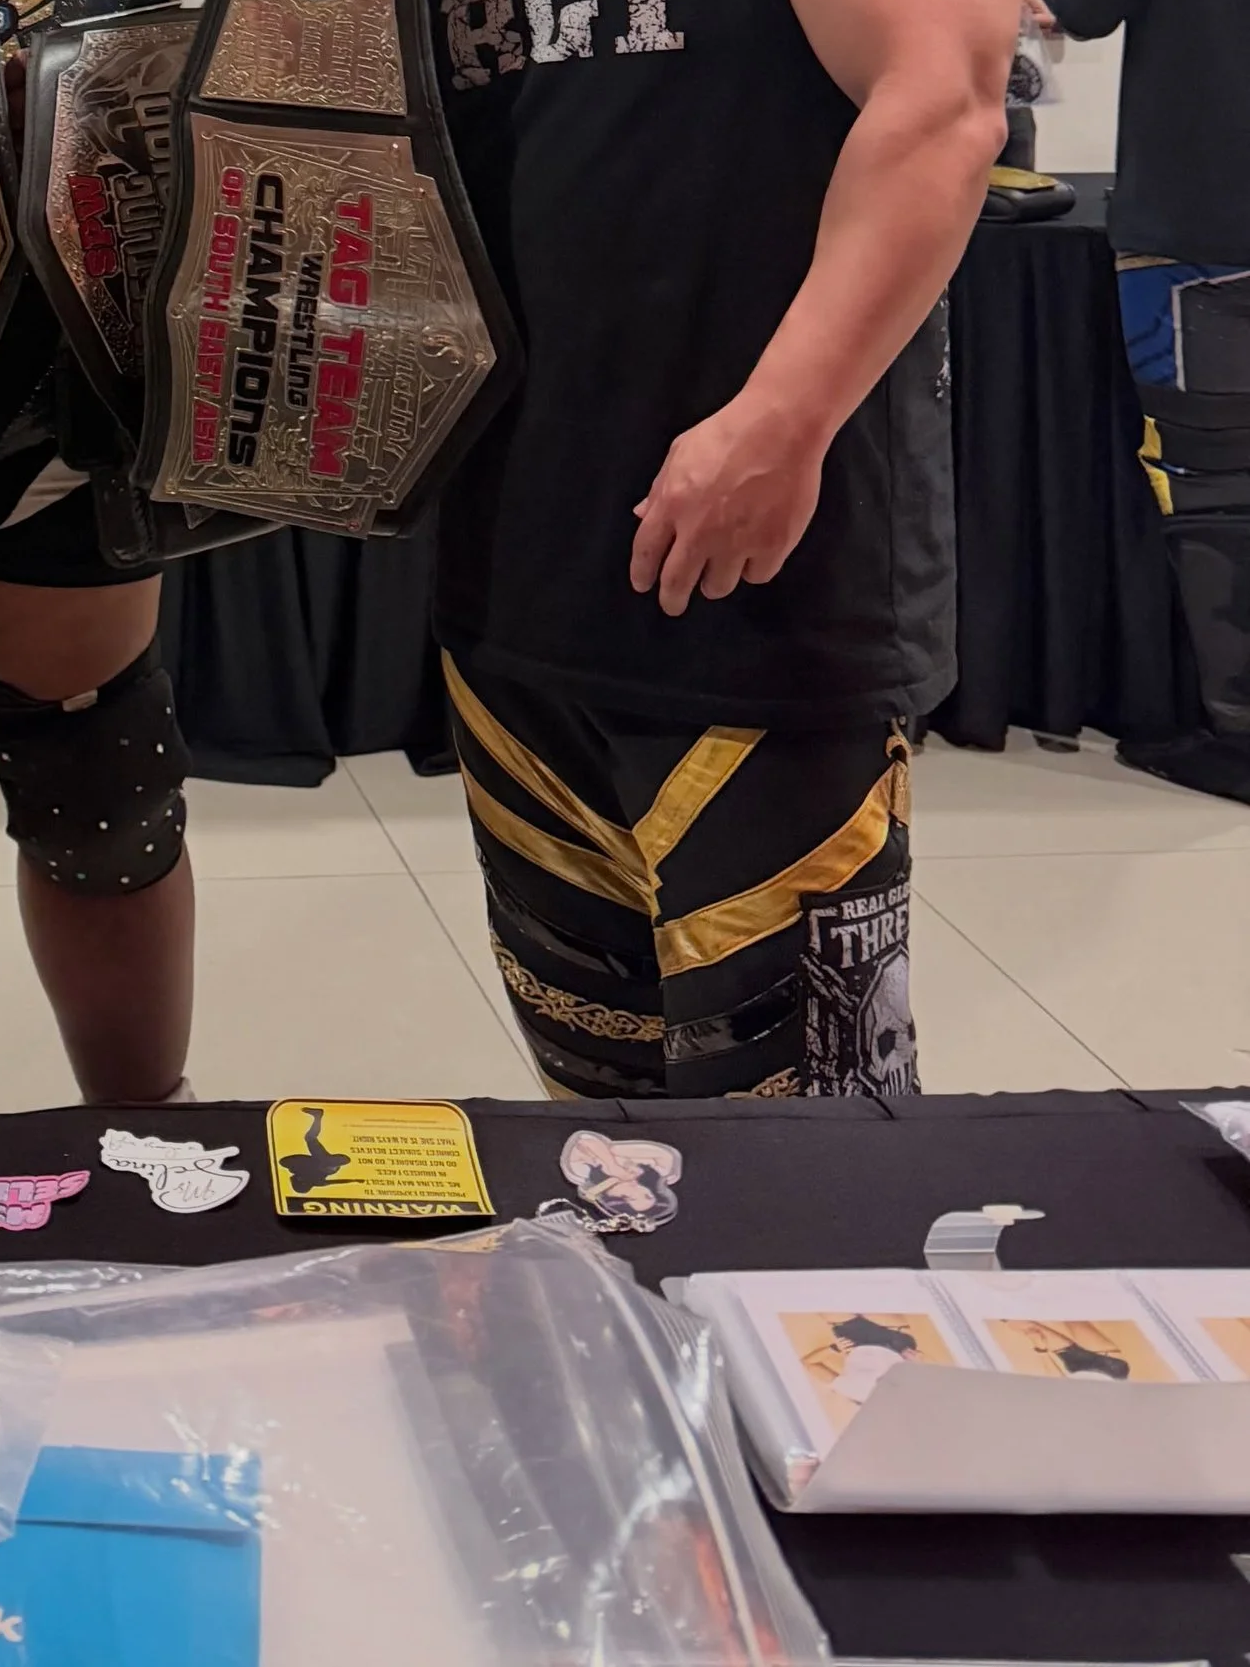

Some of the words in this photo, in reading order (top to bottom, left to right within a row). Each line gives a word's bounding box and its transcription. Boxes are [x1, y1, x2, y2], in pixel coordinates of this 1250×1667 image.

[67, 174, 117, 277] SPW
[219, 167, 247, 209] OF
[203, 212, 242, 315] SOUTH
[327, 192, 376, 309] TAG
[193, 316, 232, 397] EAST
[226, 173, 286, 473] CHAMPIONS
[285, 251, 327, 413] WRESTLING
[191, 397, 224, 466] ASIA
[307, 327, 369, 480] TEAM
[841, 893, 887, 921] REAL
[302, 1201, 465, 1215] WARNING
